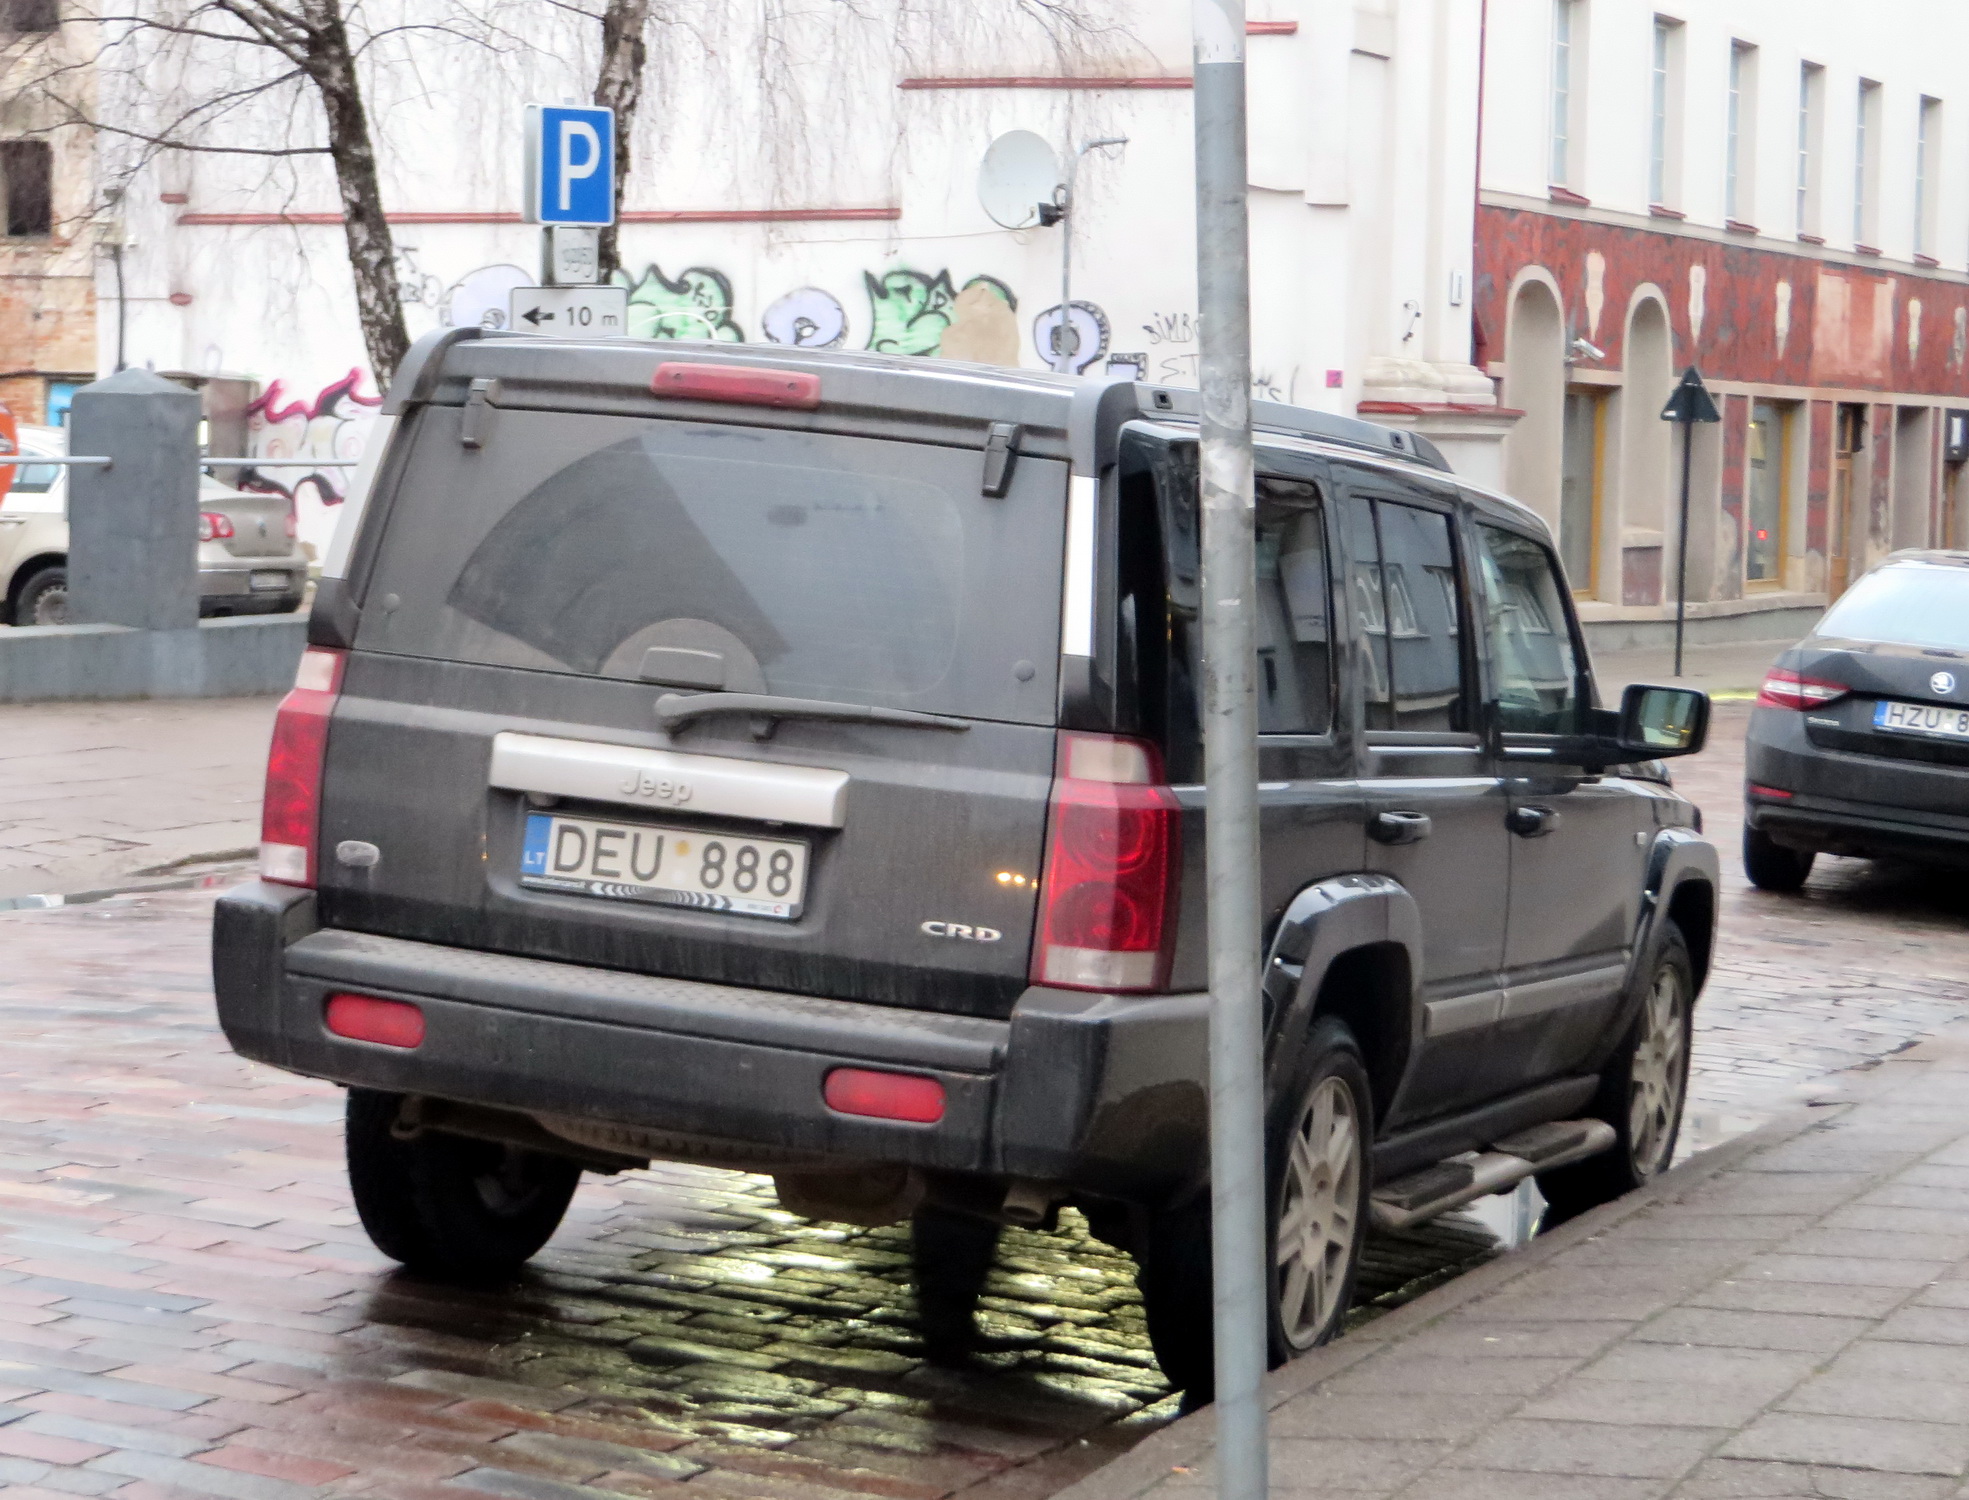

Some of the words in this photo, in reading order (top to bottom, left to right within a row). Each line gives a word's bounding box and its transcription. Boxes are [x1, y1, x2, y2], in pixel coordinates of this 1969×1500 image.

[558, 120, 601, 211] P
[566, 306, 592, 326] 10
[602, 313, 618, 326] m
[1888, 704, 1941, 729] HZU
[1957, 712, 1969, 733] 8
[620, 769, 694, 806] Jeep
[523, 849, 545, 865] LT
[553, 823, 665, 882] DEU
[699, 840, 795, 898] 888
[921, 921, 1002, 941] CRD
